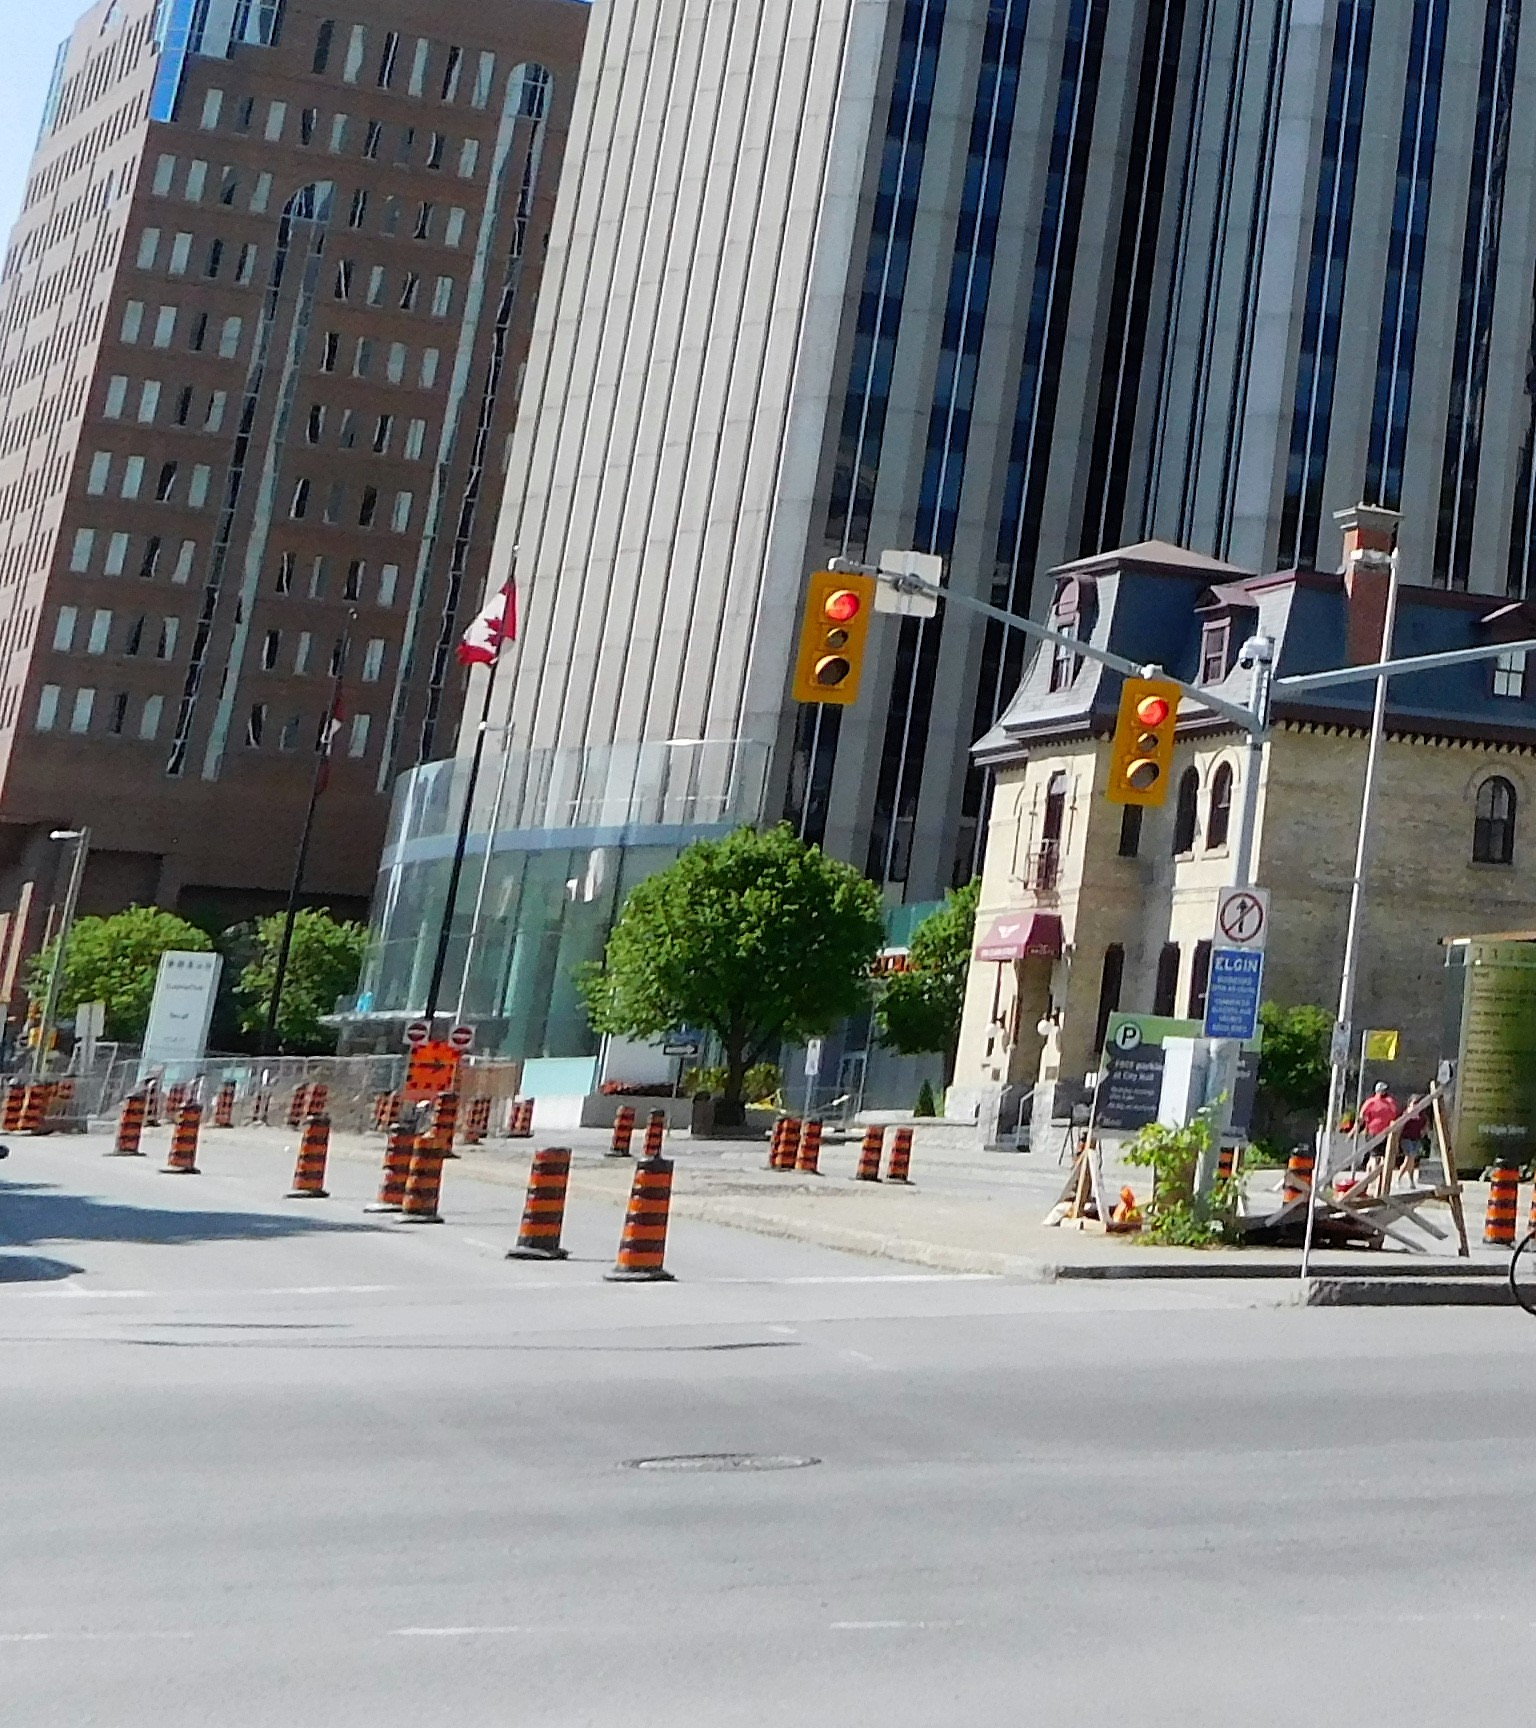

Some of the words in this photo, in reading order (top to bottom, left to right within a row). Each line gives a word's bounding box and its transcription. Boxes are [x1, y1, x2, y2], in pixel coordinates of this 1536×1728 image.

[1214, 957, 1258, 972] ELGIN
[1121, 1027, 1136, 1045] P
[1136, 1061, 1163, 1072] parkin
